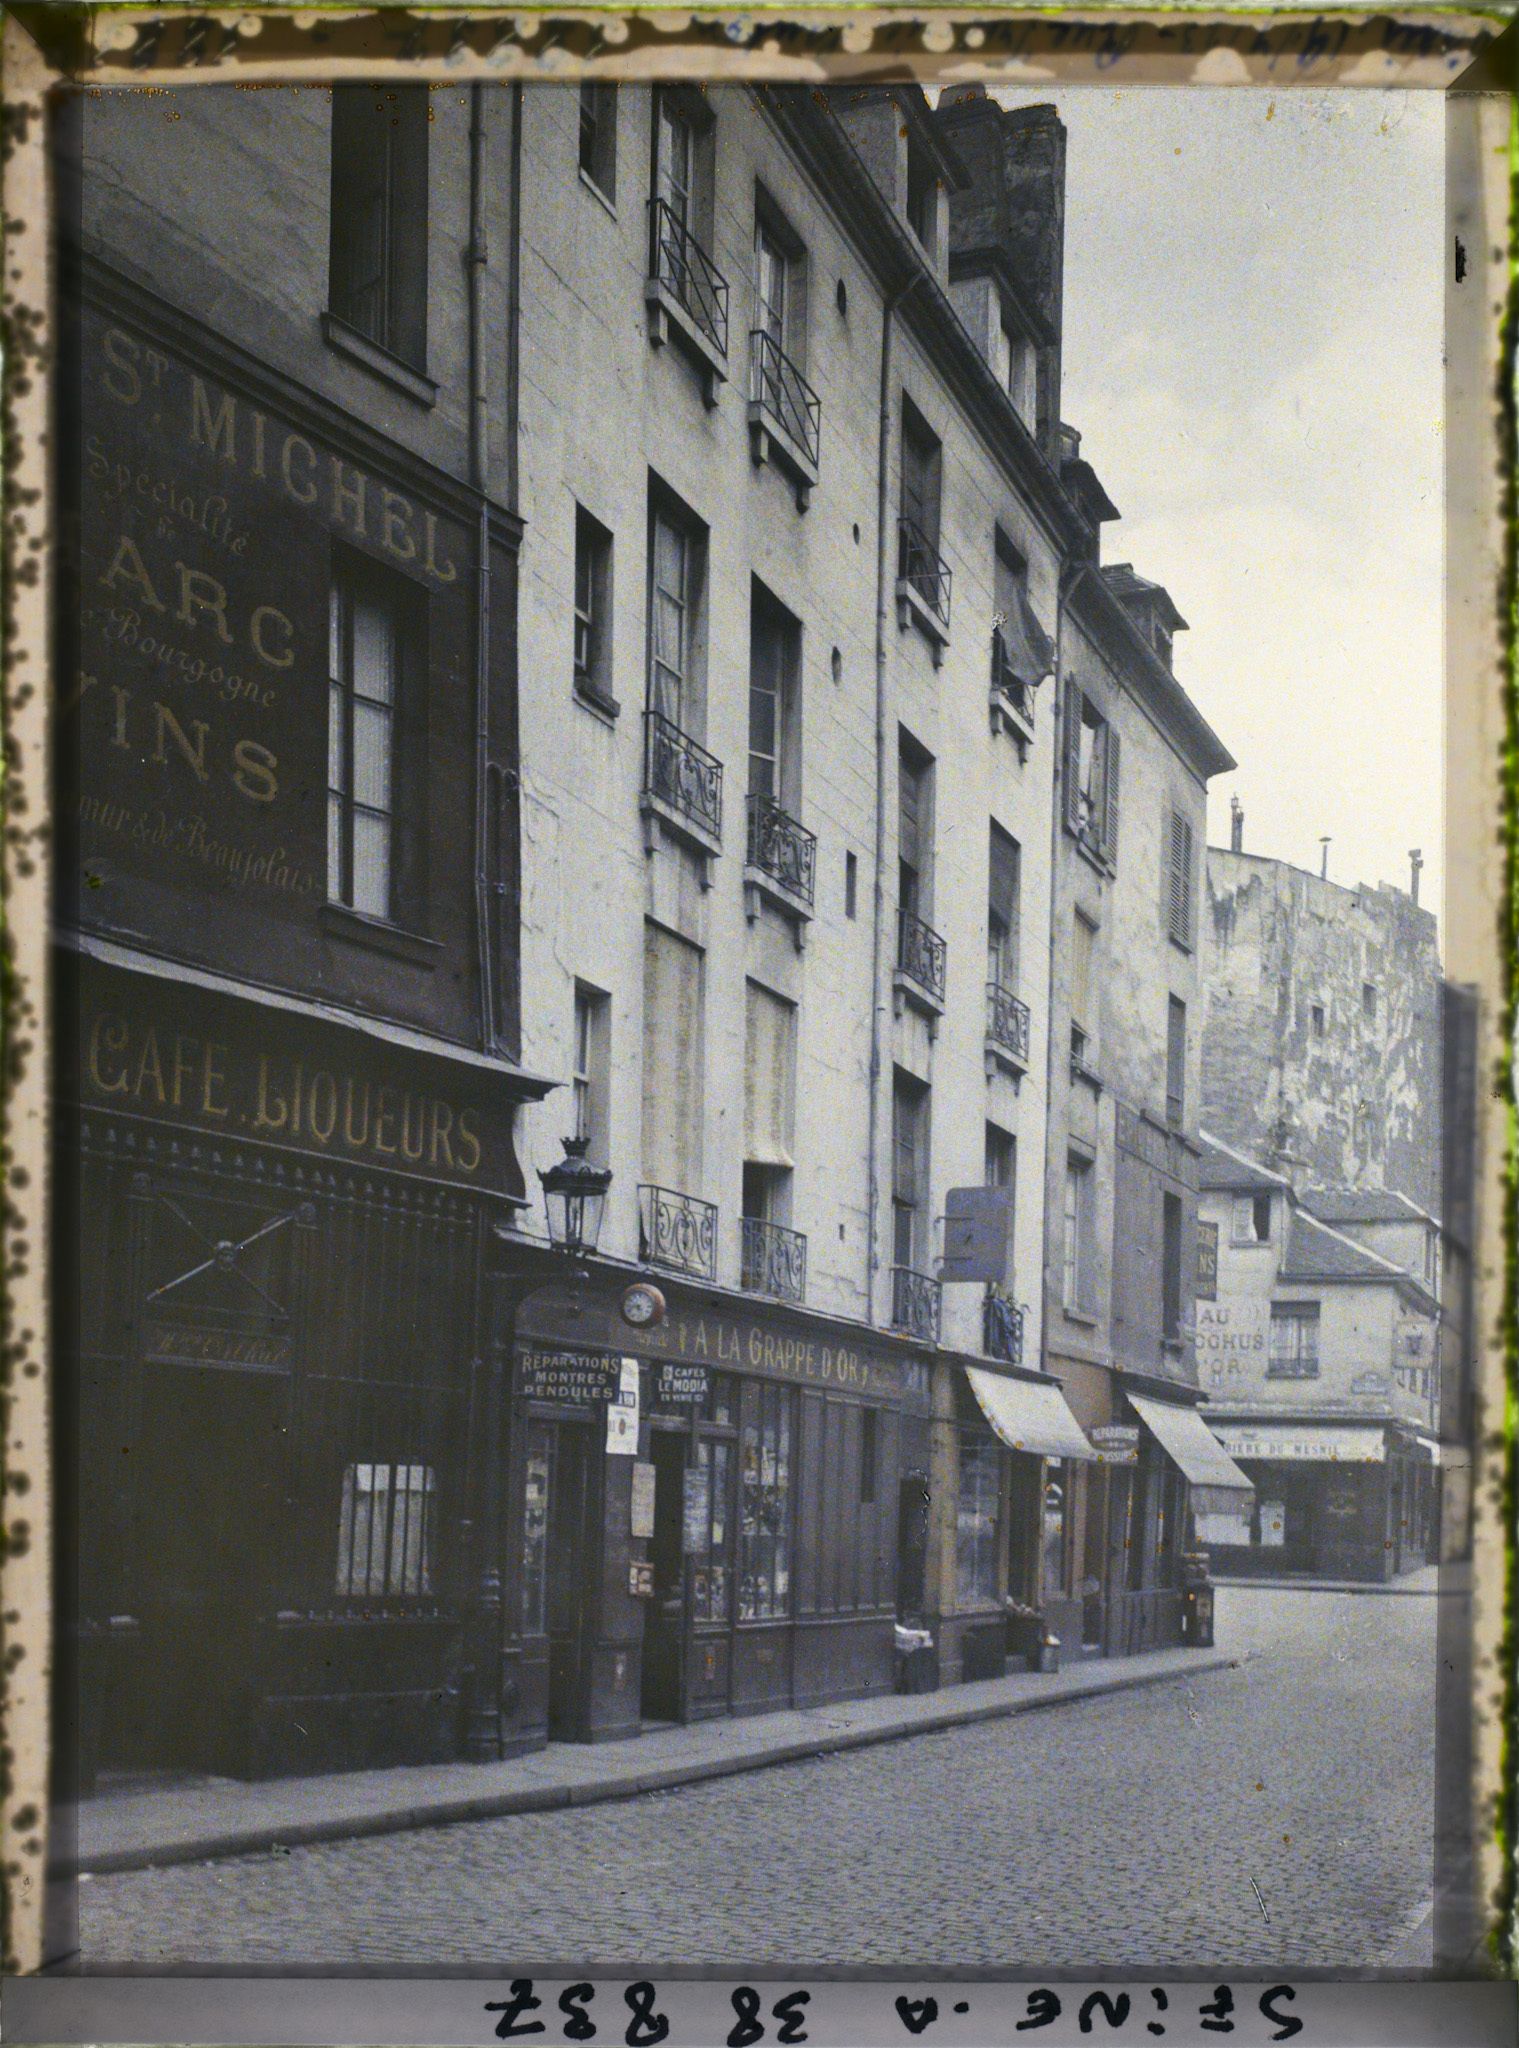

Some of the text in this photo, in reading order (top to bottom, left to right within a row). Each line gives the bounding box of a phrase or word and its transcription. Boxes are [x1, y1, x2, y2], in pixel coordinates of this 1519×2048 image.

[190, 374, 457, 583] MICHEL
[104, 607, 276, 707] Bourgogne
[253, 1053, 482, 1171] LIQUEURS
[1201, 1308, 1231, 1326] AU
[535, 1370, 608, 1386] MONTRES
[695, 1319, 708, 1356] A
[719, 1322, 740, 1361] LA
[749, 1327, 815, 1378] GRAPPE
[524, 1384, 614, 1400] PENDULES
